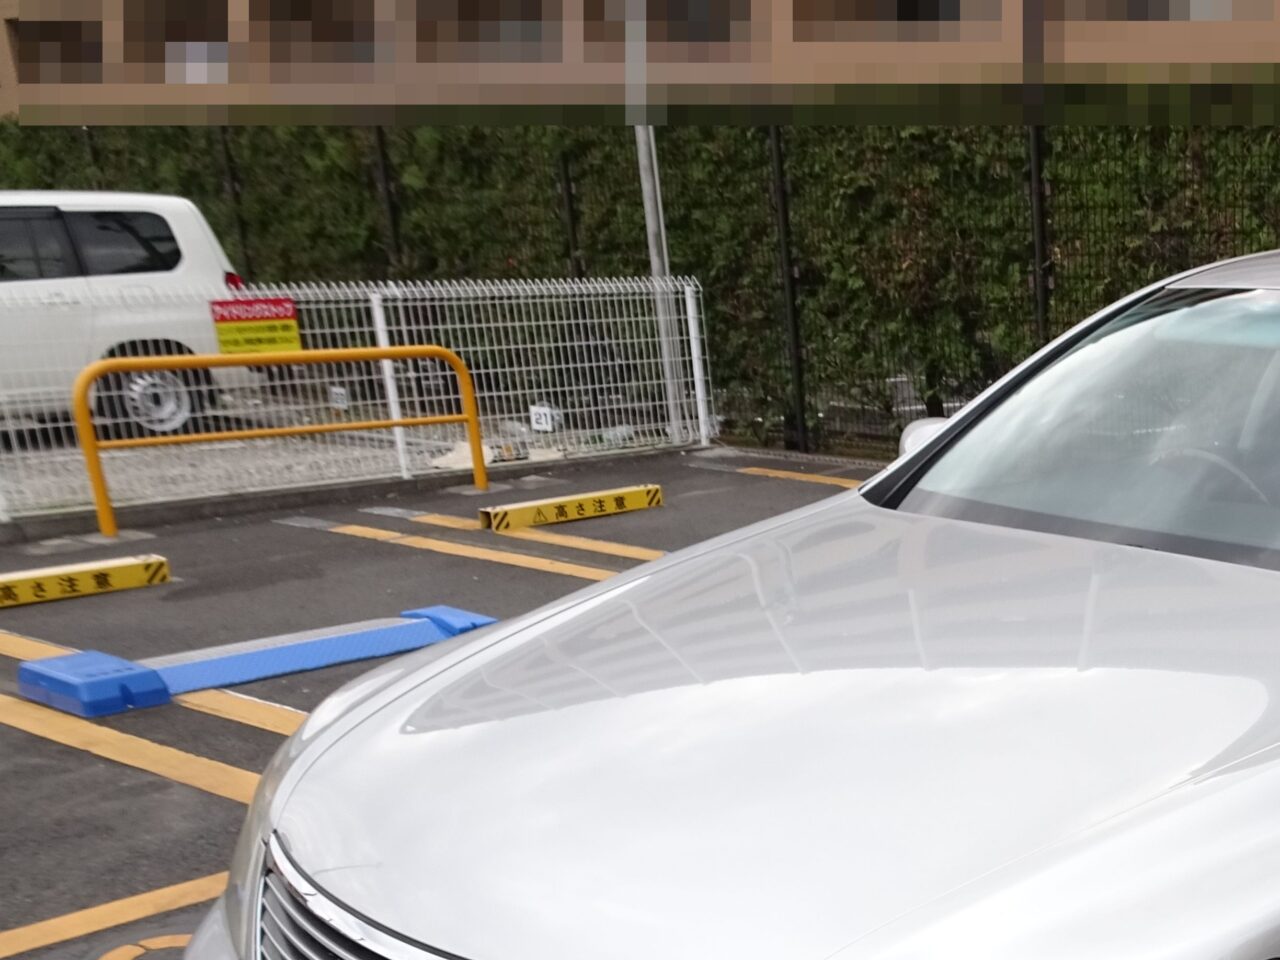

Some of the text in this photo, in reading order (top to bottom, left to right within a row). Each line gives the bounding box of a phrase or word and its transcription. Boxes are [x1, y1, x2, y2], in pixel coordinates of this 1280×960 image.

[534, 411, 549, 426] 21
[554, 496, 626, 520] 高さ注意
